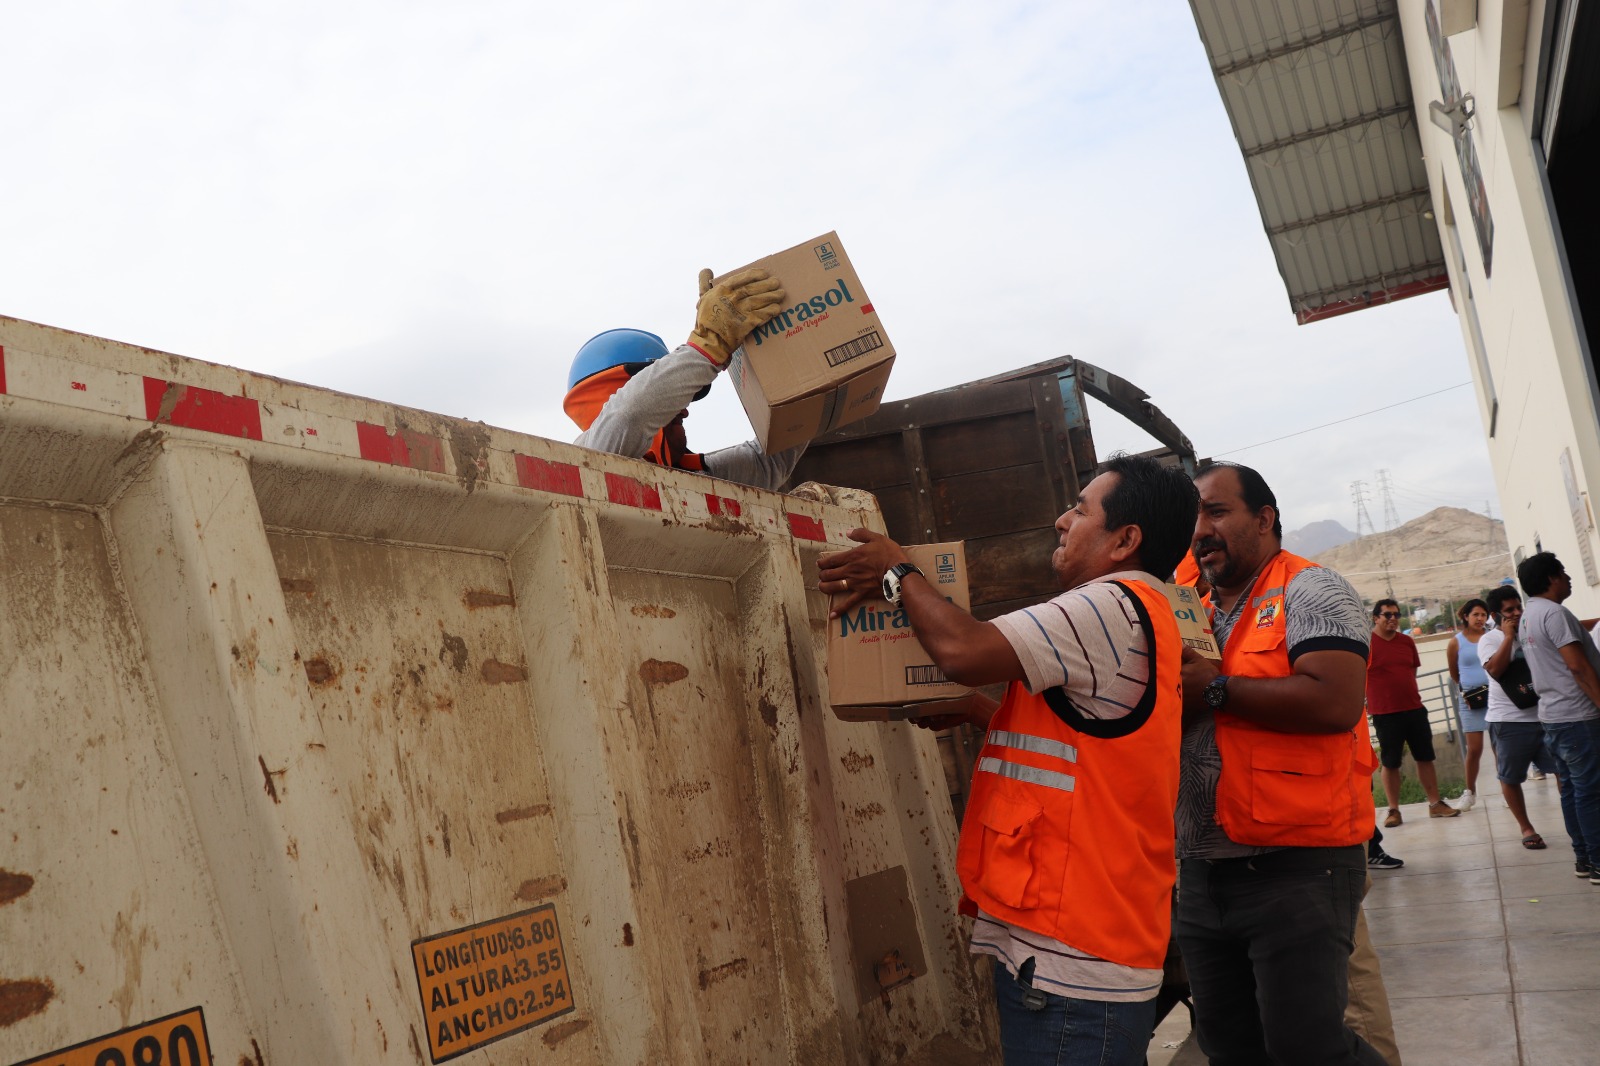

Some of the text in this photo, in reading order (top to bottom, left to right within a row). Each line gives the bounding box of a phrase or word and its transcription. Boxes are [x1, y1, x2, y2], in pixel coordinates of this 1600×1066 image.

[820, 245, 828, 254] 8
[752, 278, 854, 346] Mirasol
[803, 312, 830, 328] Vegetal
[71, 381, 87, 392] 3M
[942, 555, 949, 565] 8
[840, 605, 917, 638] Mira
[881, 631, 910, 644] Vegetal
